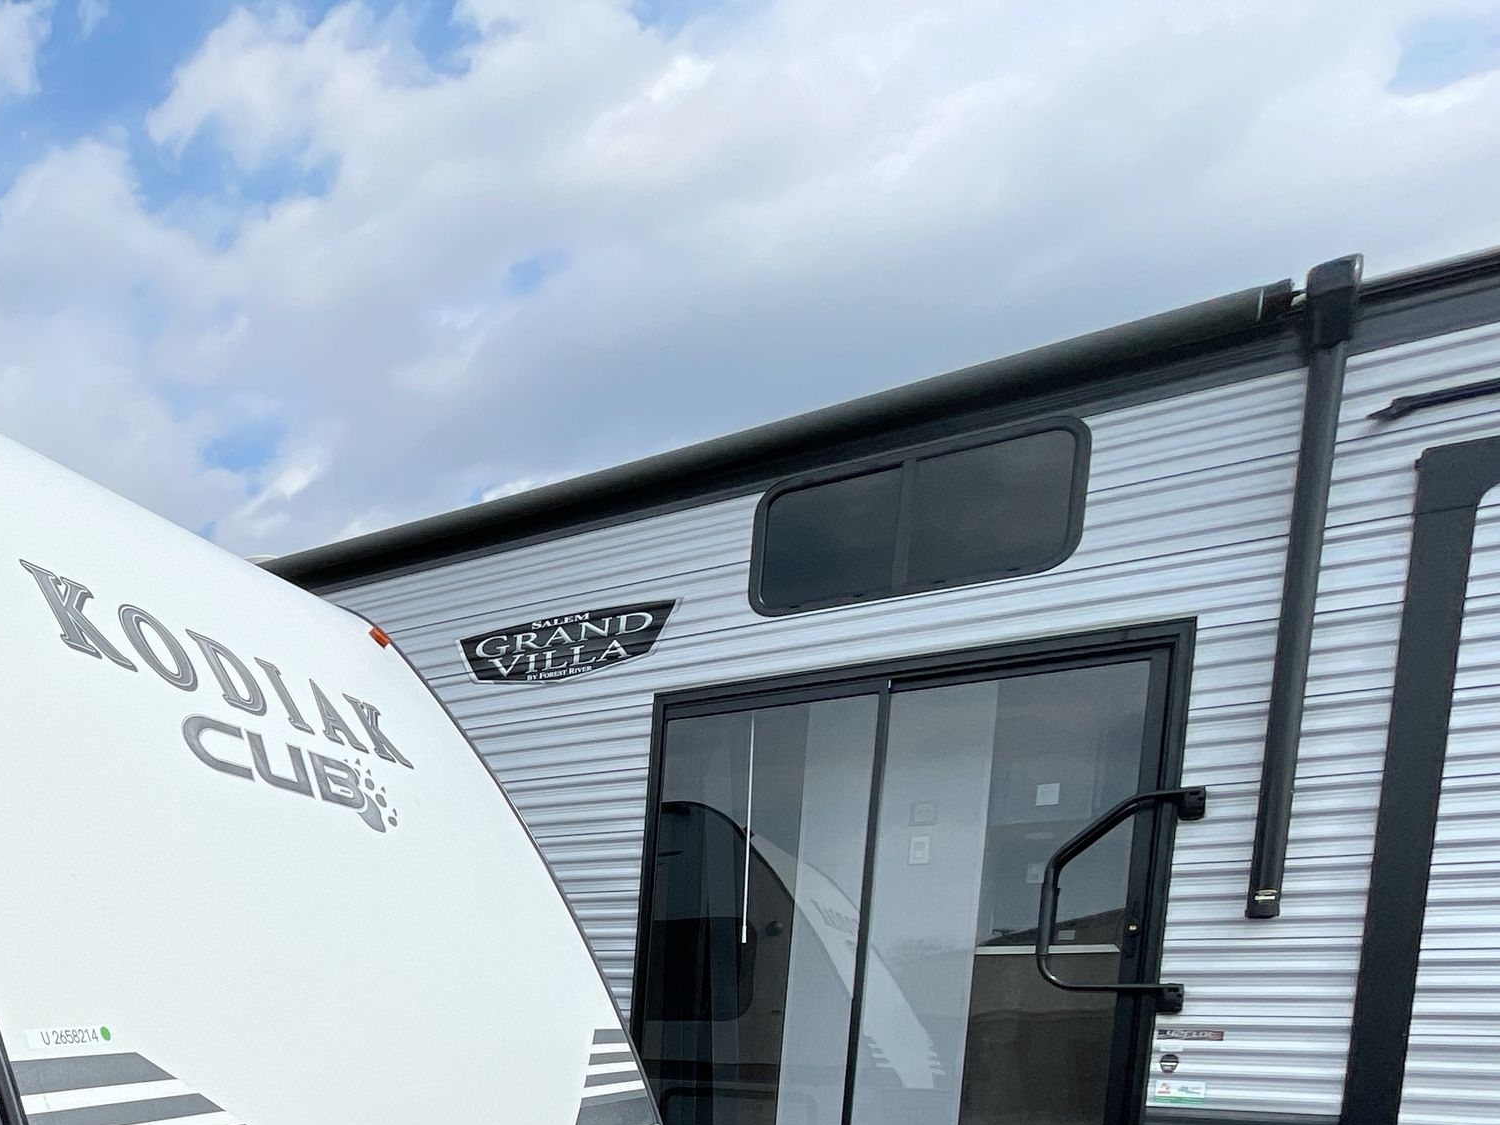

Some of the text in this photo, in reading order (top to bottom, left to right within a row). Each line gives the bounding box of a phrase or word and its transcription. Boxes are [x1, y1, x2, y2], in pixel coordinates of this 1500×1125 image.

[474, 611, 654, 659] GRAND
[531, 612, 591, 631] SALEM
[19, 558, 415, 770] KODIAK
[488, 639, 632, 678] VILLA
[539, 668, 568, 680] FOREST
[568, 664, 593, 676] RIVER
[181, 713, 369, 812] CUB
[40, 1028, 99, 1046] U 2658214
